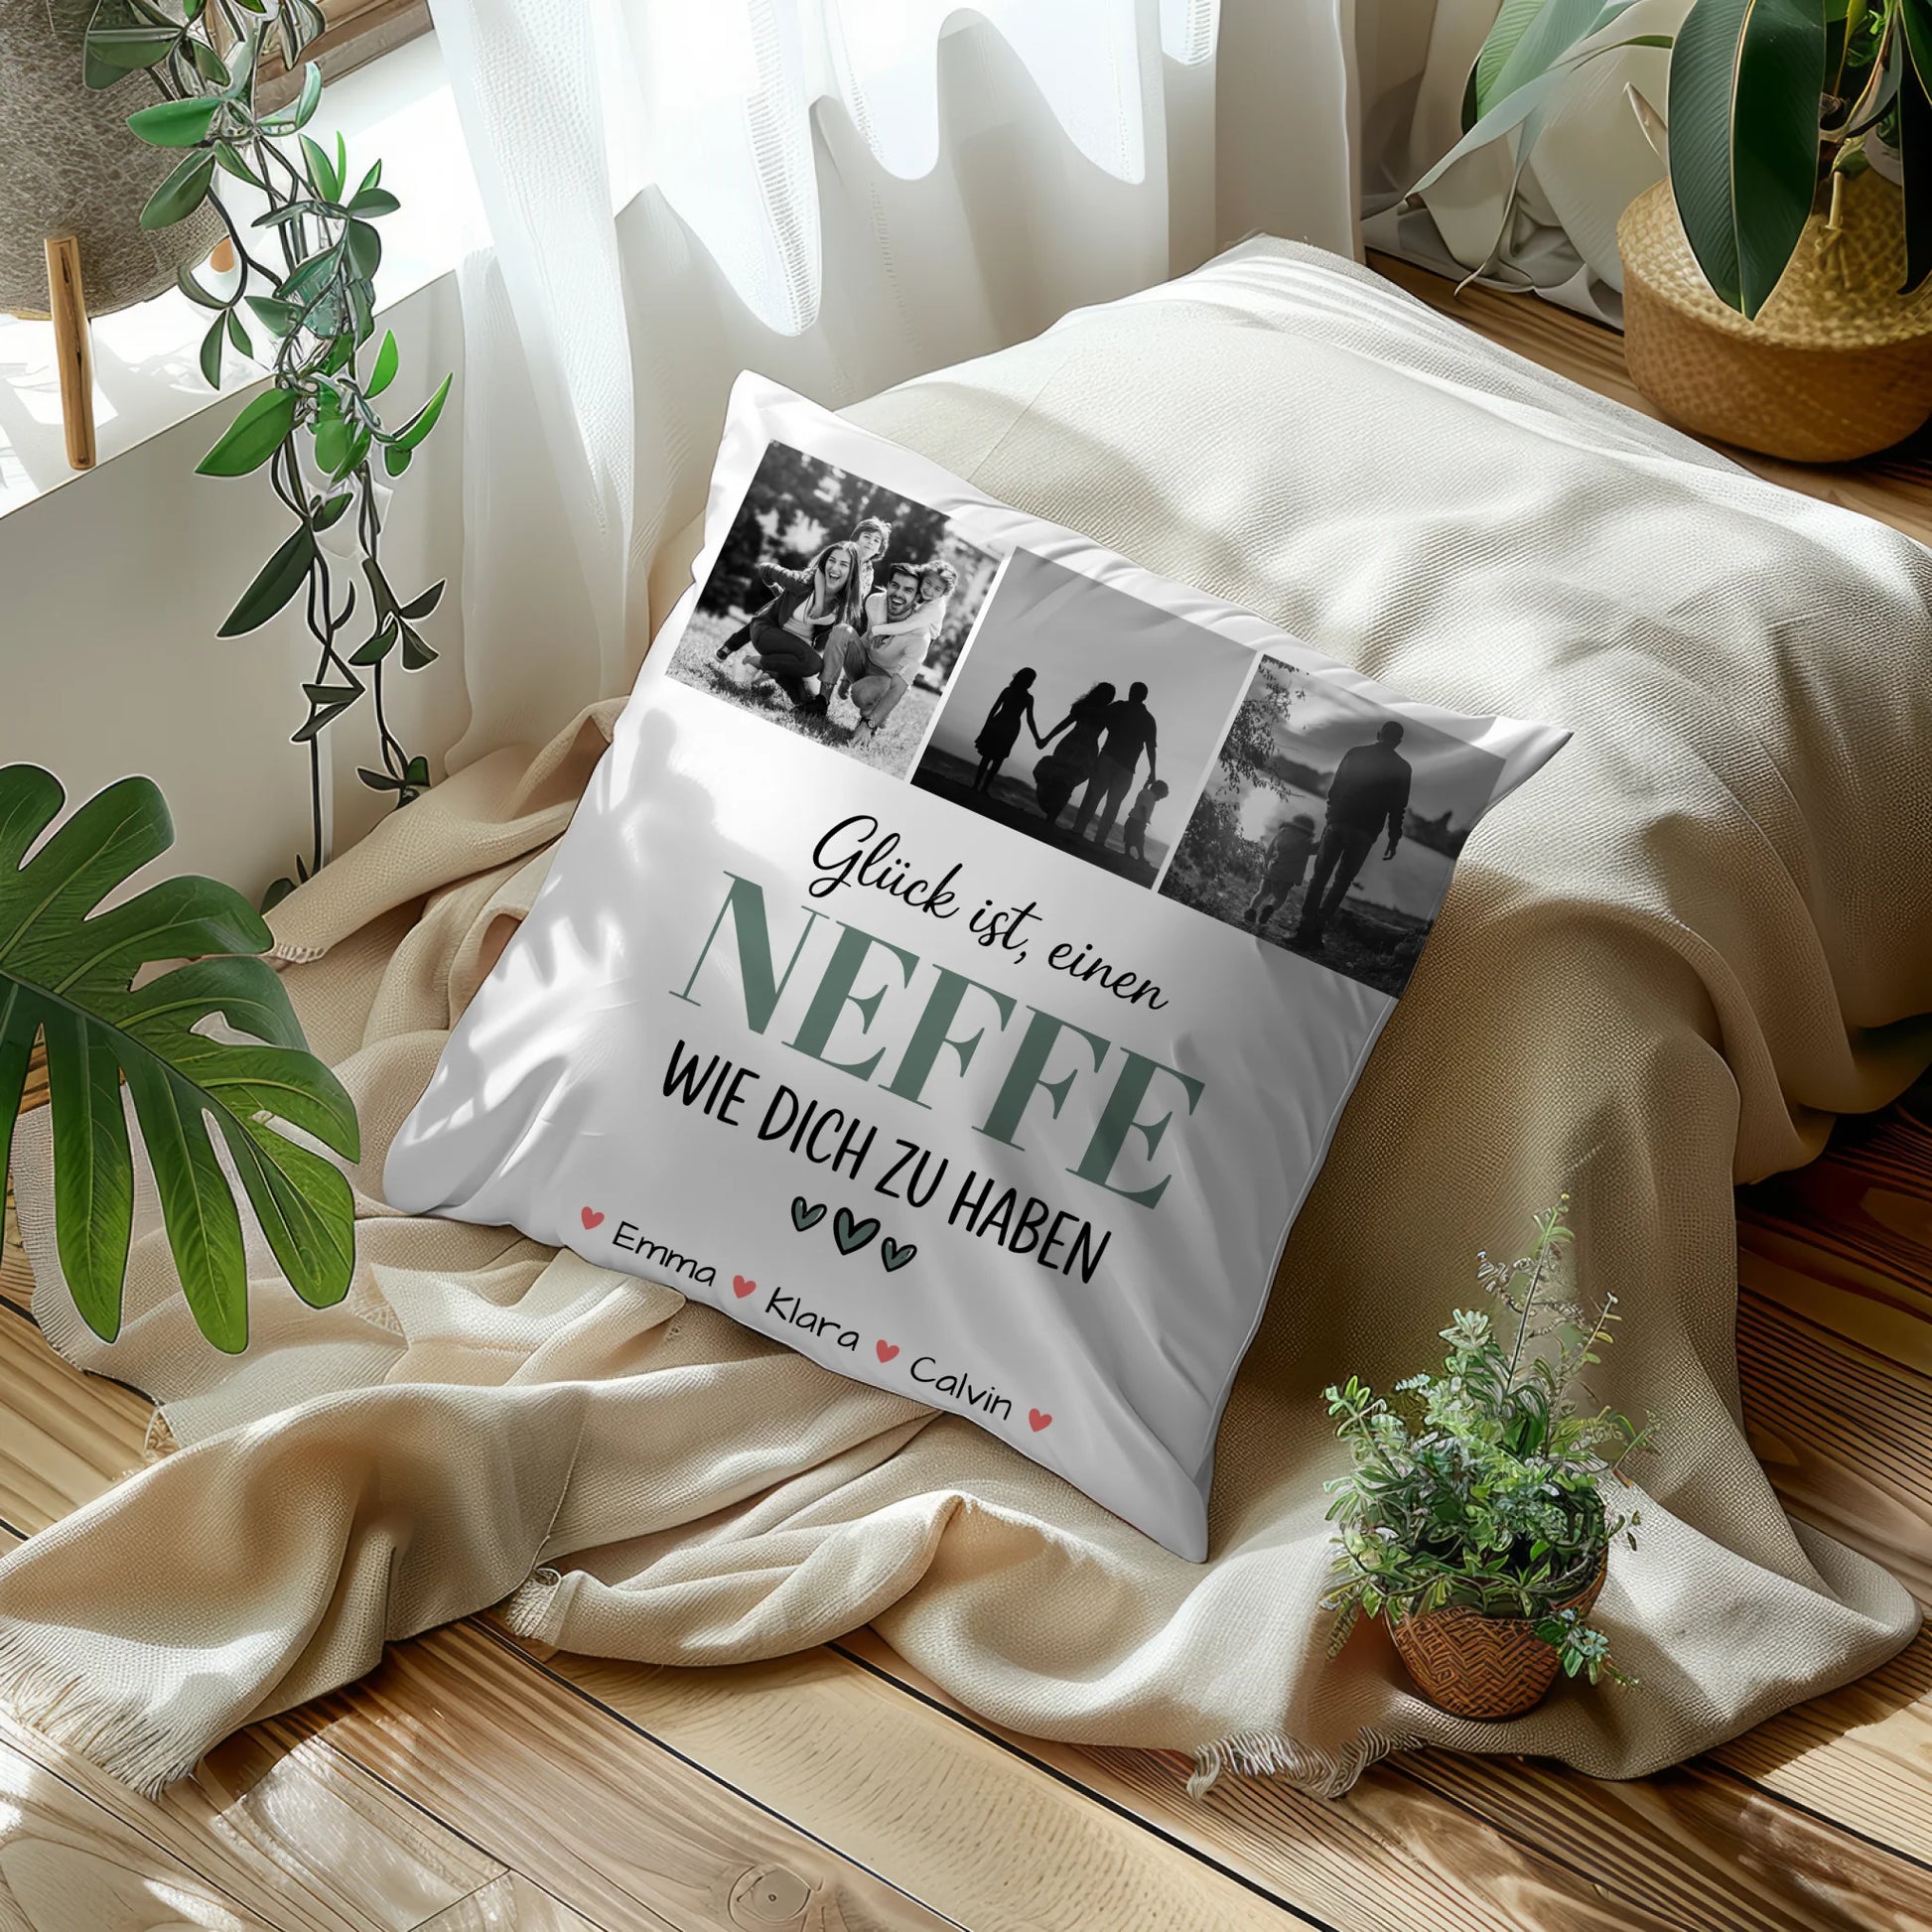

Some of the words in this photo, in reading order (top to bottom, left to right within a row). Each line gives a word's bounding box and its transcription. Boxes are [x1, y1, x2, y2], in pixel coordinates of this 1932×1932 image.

[808, 814, 963, 918] Glück
[970, 898, 1042, 963] ist,
[1048, 942, 1169, 1010] einen
[669, 871, 1205, 1209] NEFFE
[662, 1038, 759, 1126] WIE
[758, 1084, 877, 1179] DICH
[875, 1138, 948, 1208] ZU
[948, 1170, 1111, 1284] HABEN
[613, 1221, 717, 1287] Emma
[765, 1287, 859, 1351] Klara
[910, 1356, 1012, 1421] Calvin
